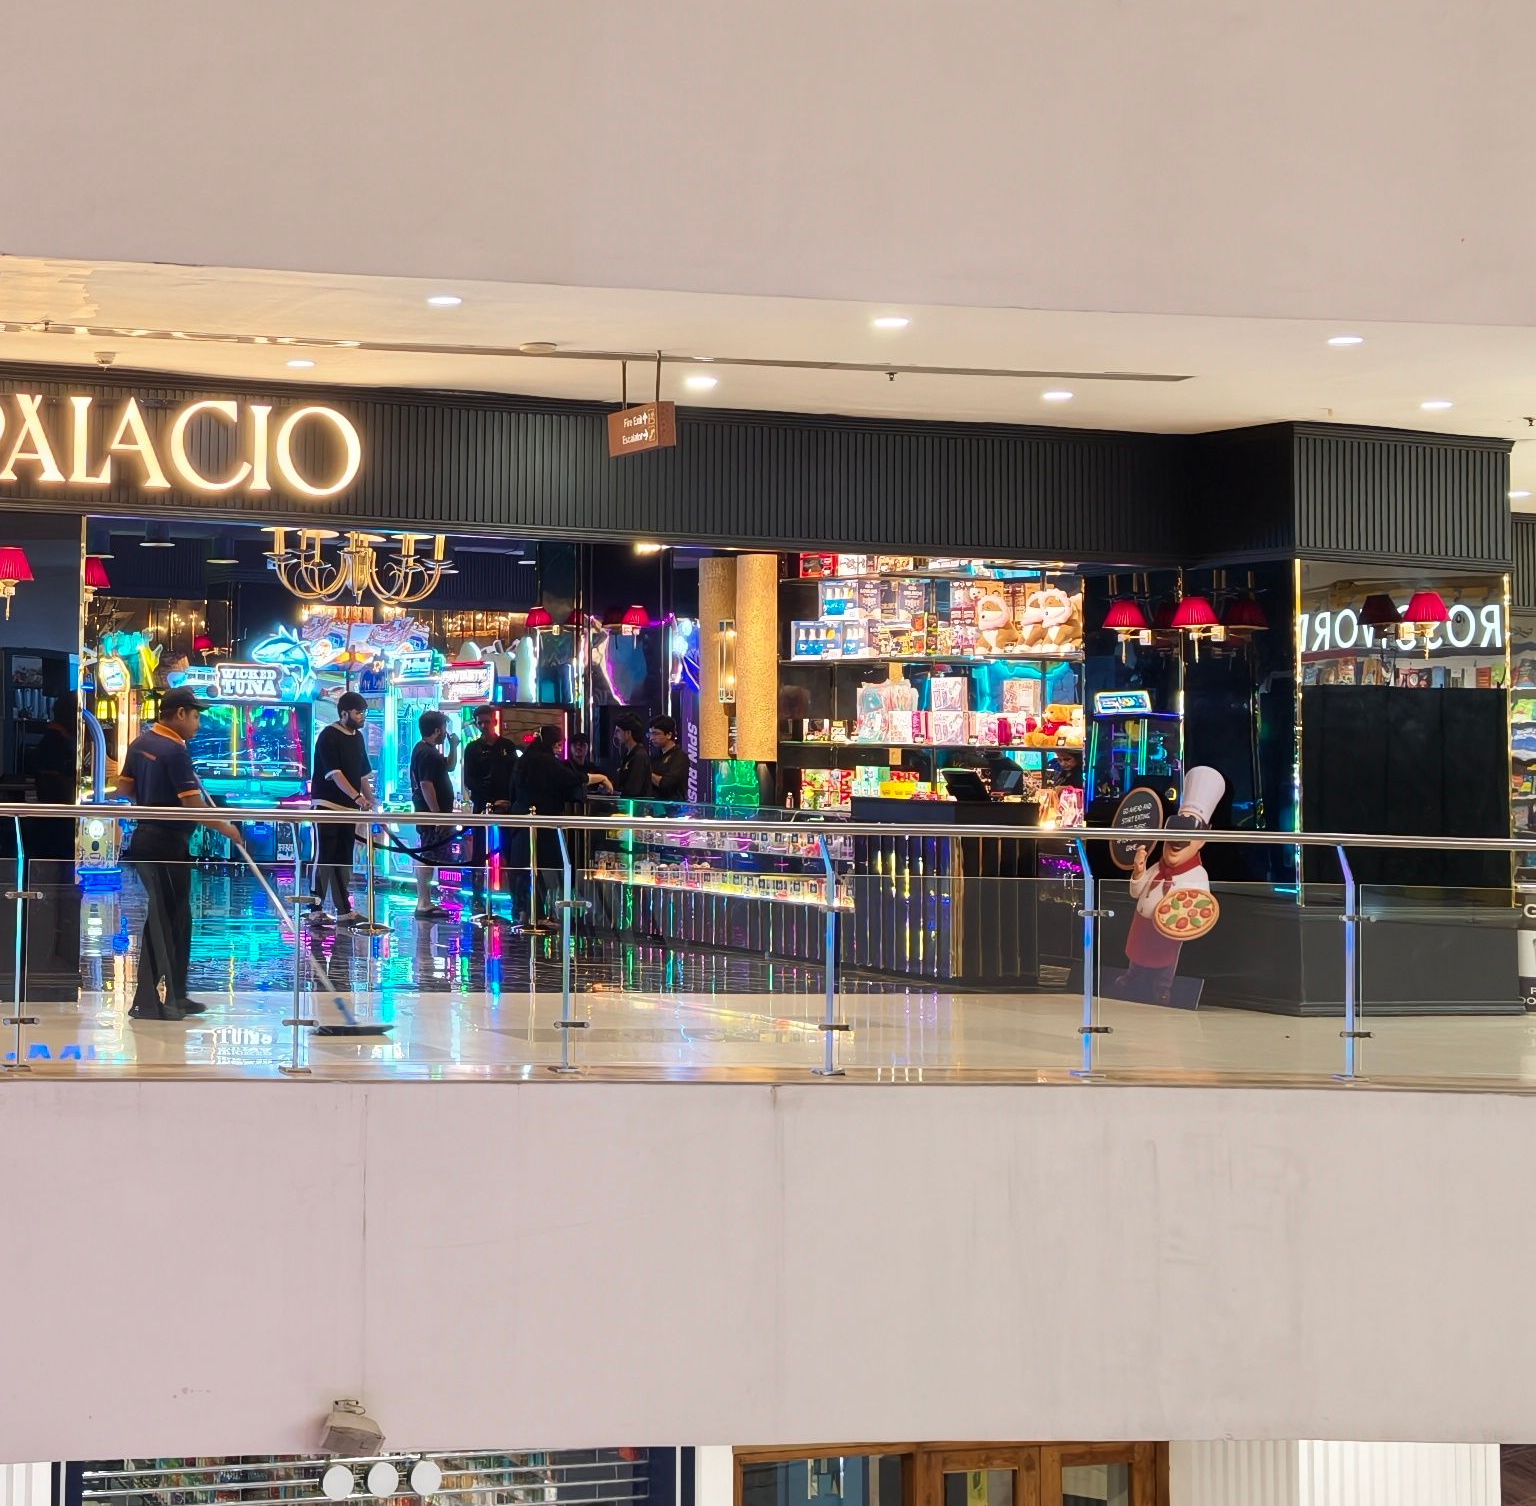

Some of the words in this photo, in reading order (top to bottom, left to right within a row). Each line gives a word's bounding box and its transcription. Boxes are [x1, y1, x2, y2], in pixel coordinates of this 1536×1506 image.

[220, 668, 276, 681] WICKED
[221, 680, 276, 696] TUNA
[687, 721, 698, 764] SPIN
[687, 768, 698, 805] RUS
